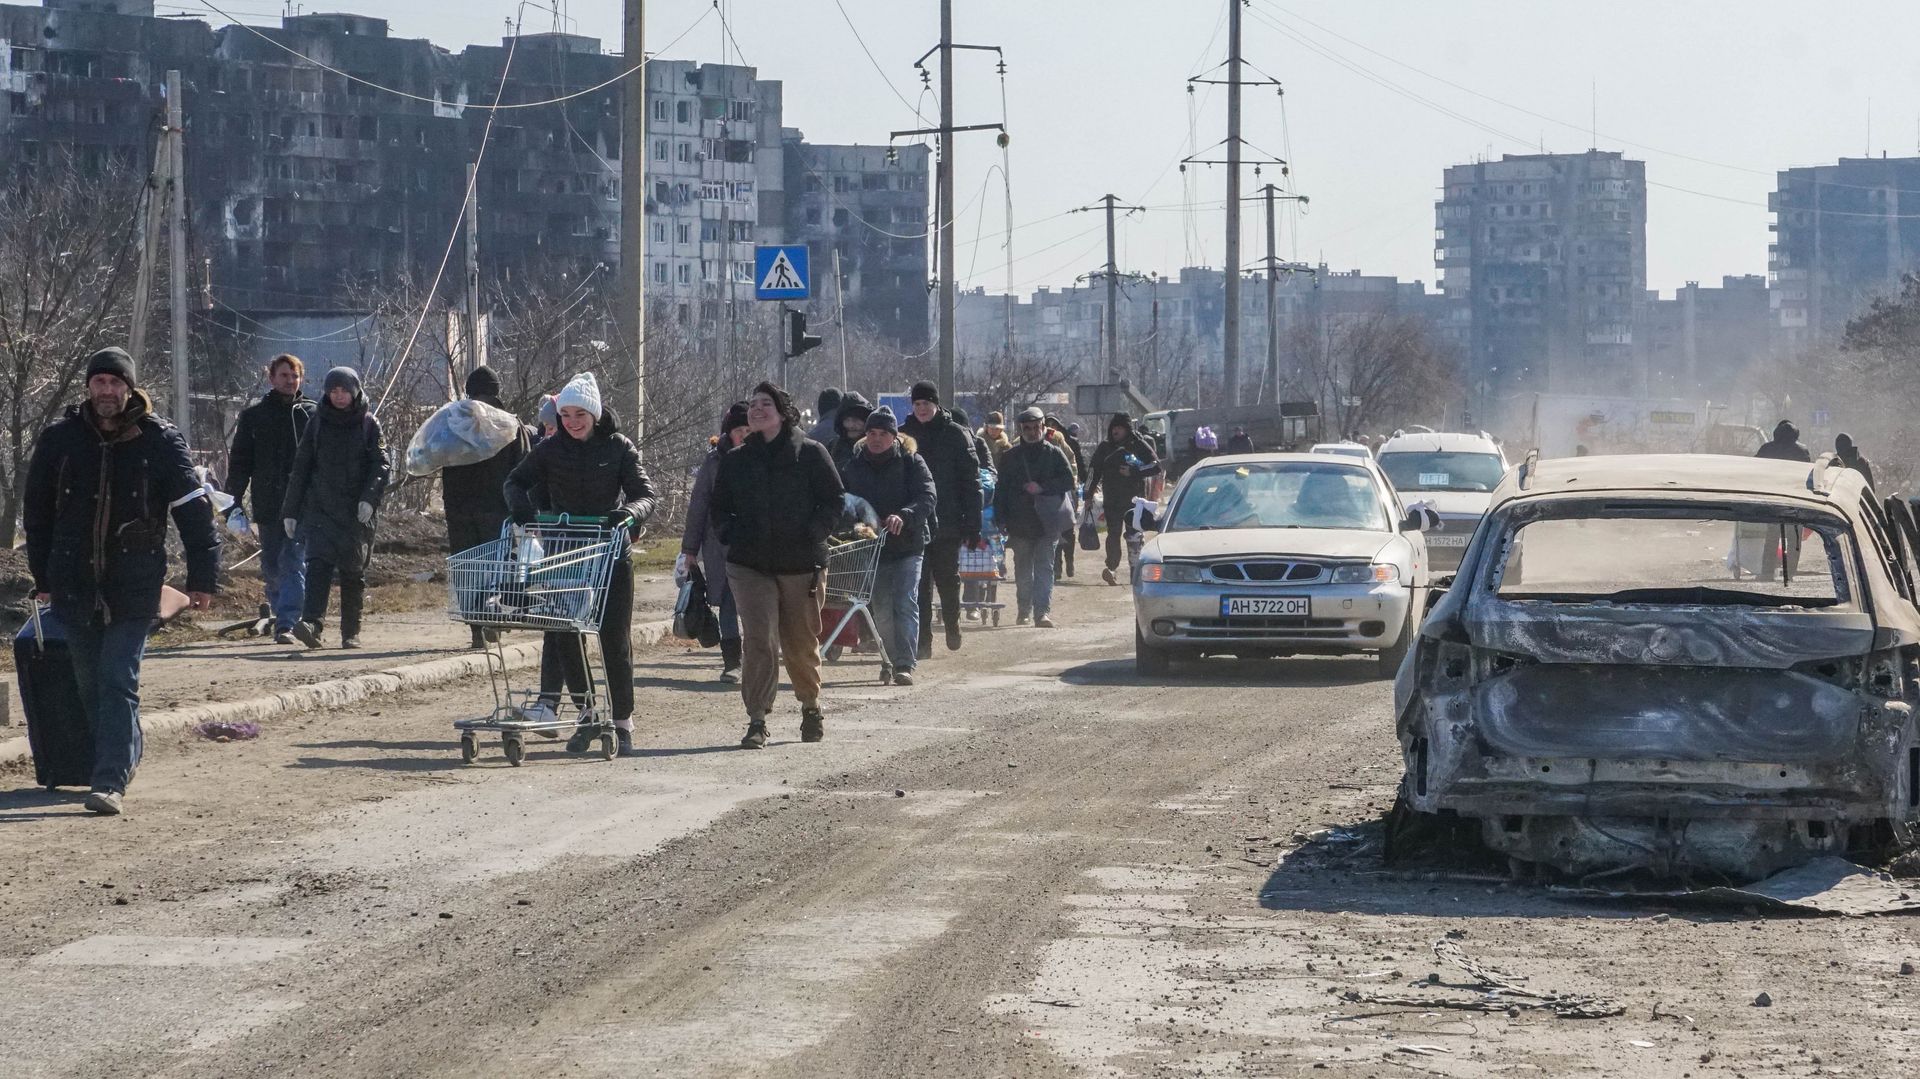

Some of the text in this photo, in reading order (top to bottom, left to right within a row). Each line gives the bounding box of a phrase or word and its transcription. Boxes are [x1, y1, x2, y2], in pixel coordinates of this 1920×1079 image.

[1231, 600, 1307, 613] AH 3722 OH
